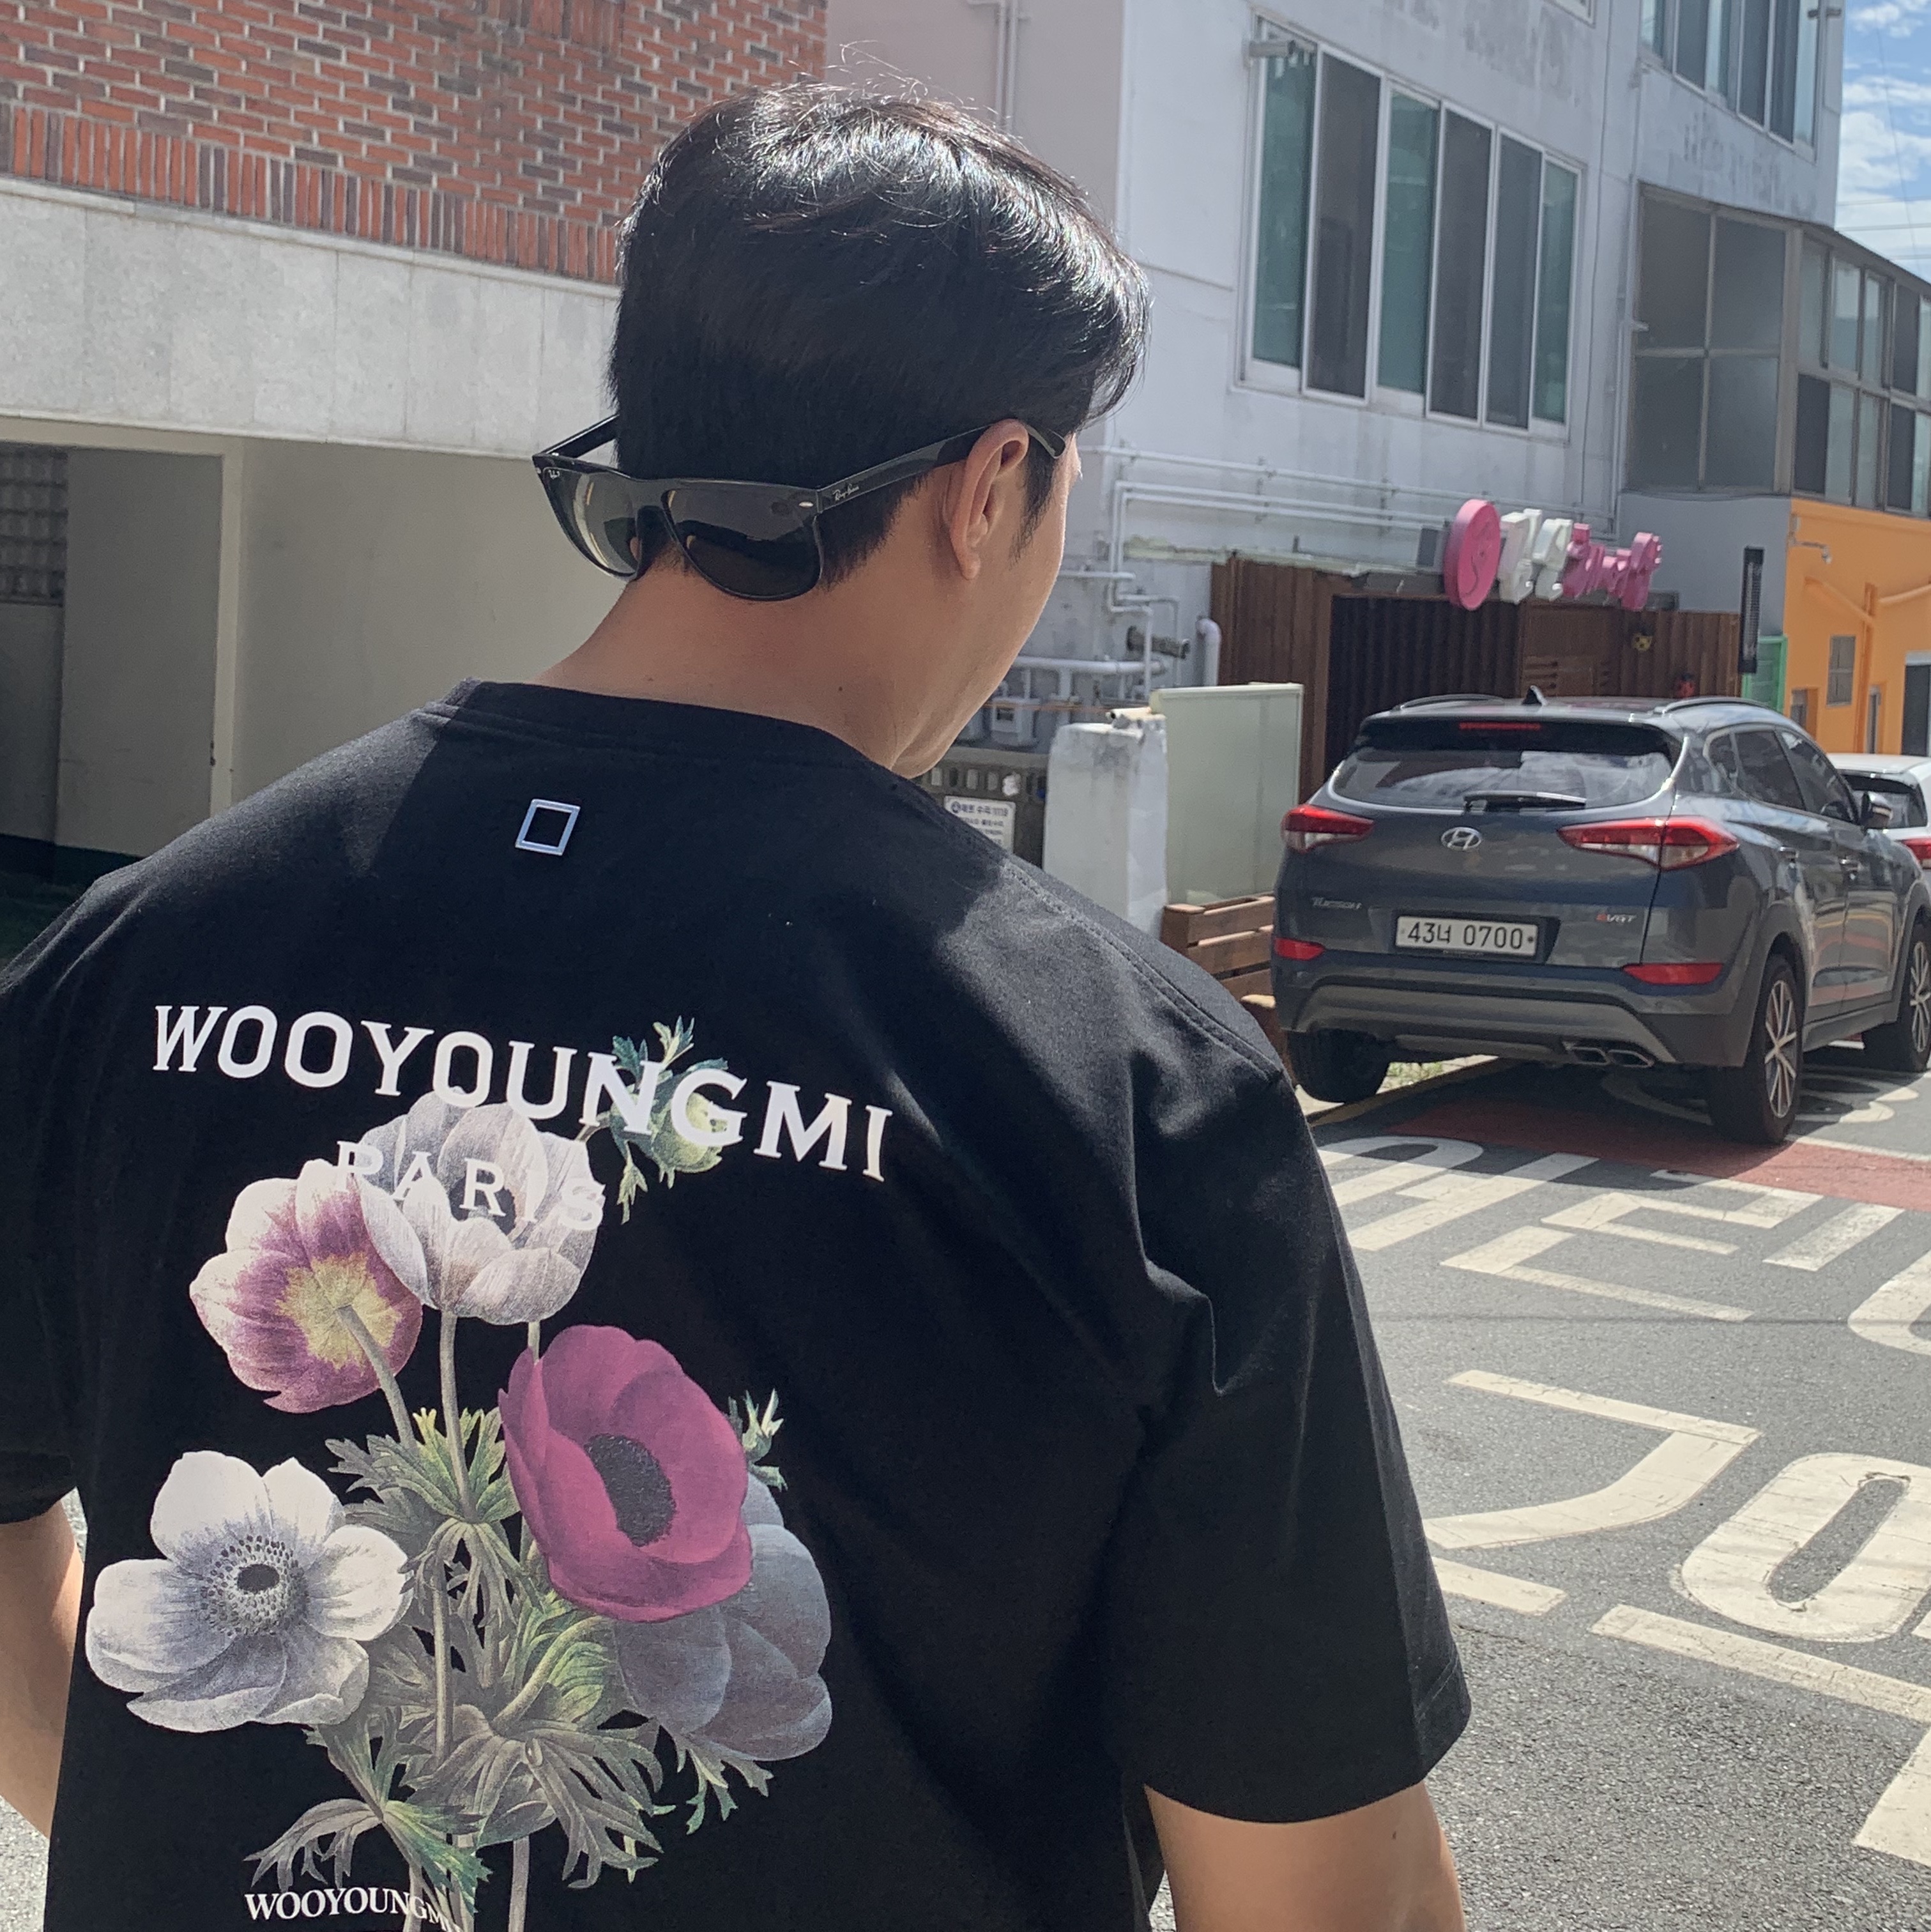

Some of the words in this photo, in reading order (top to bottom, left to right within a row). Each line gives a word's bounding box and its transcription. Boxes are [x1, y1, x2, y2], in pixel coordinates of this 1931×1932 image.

[1407, 921, 1452, 944] 43너
[1463, 924, 1523, 949] 0700
[153, 1005, 893, 1182] WOOYOUNGMI
[336, 1140, 606, 1231] PARIS
